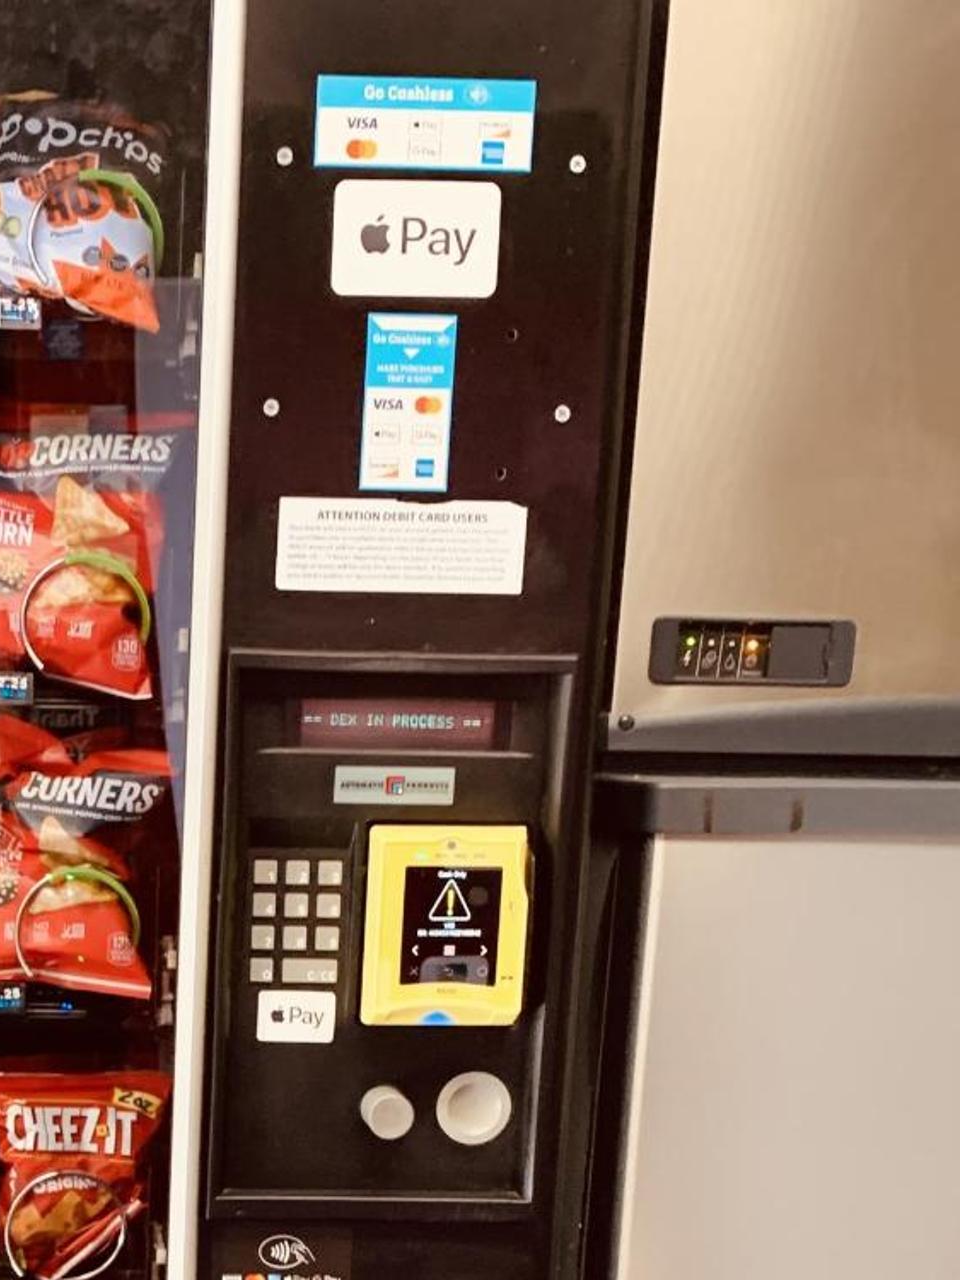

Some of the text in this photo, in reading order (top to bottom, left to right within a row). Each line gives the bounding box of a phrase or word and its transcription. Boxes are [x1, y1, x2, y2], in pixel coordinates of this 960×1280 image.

[364, 85, 454, 102] Go Cashless
[347, 117, 378, 129] VISA
[401, 217, 477, 265] Pay
[373, 399, 404, 411] VISA
[317, 510, 488, 524] ATTENTION DEBIT CARD USERS
[330, 713, 455, 730] DEX IN PROCESS
[289, 1006, 324, 1028] Pay
